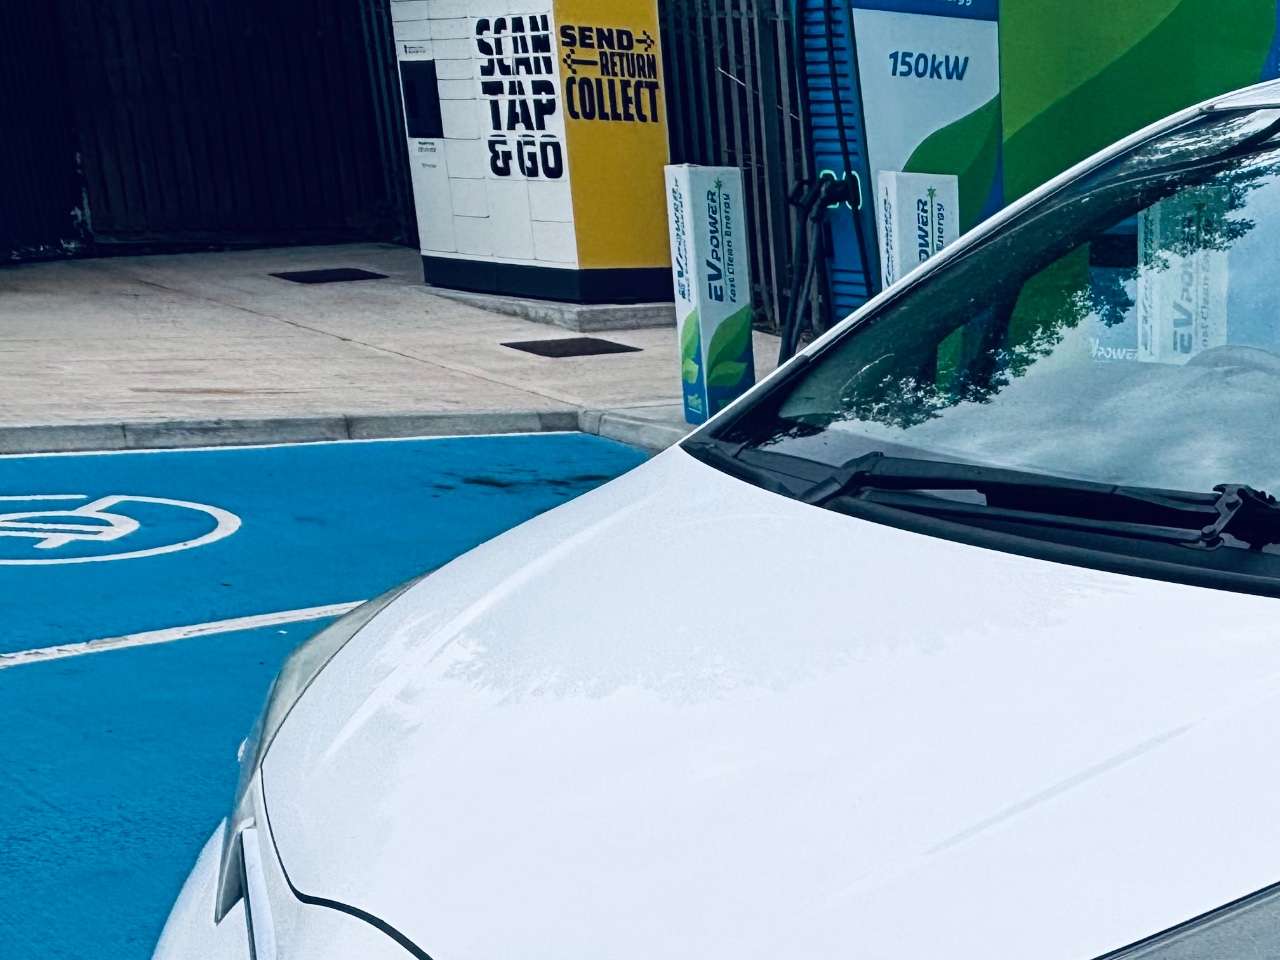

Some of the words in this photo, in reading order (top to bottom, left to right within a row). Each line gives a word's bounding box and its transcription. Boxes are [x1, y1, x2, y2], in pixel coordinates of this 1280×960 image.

[475, 14, 553, 77] SCAN
[560, 25, 634, 51] SEND
[600, 51, 657, 79] RETURN
[889, 51, 969, 80] 150kW
[480, 80, 557, 131] TAP
[565, 77, 660, 123] COLLECT
[516, 134, 564, 179] GO
